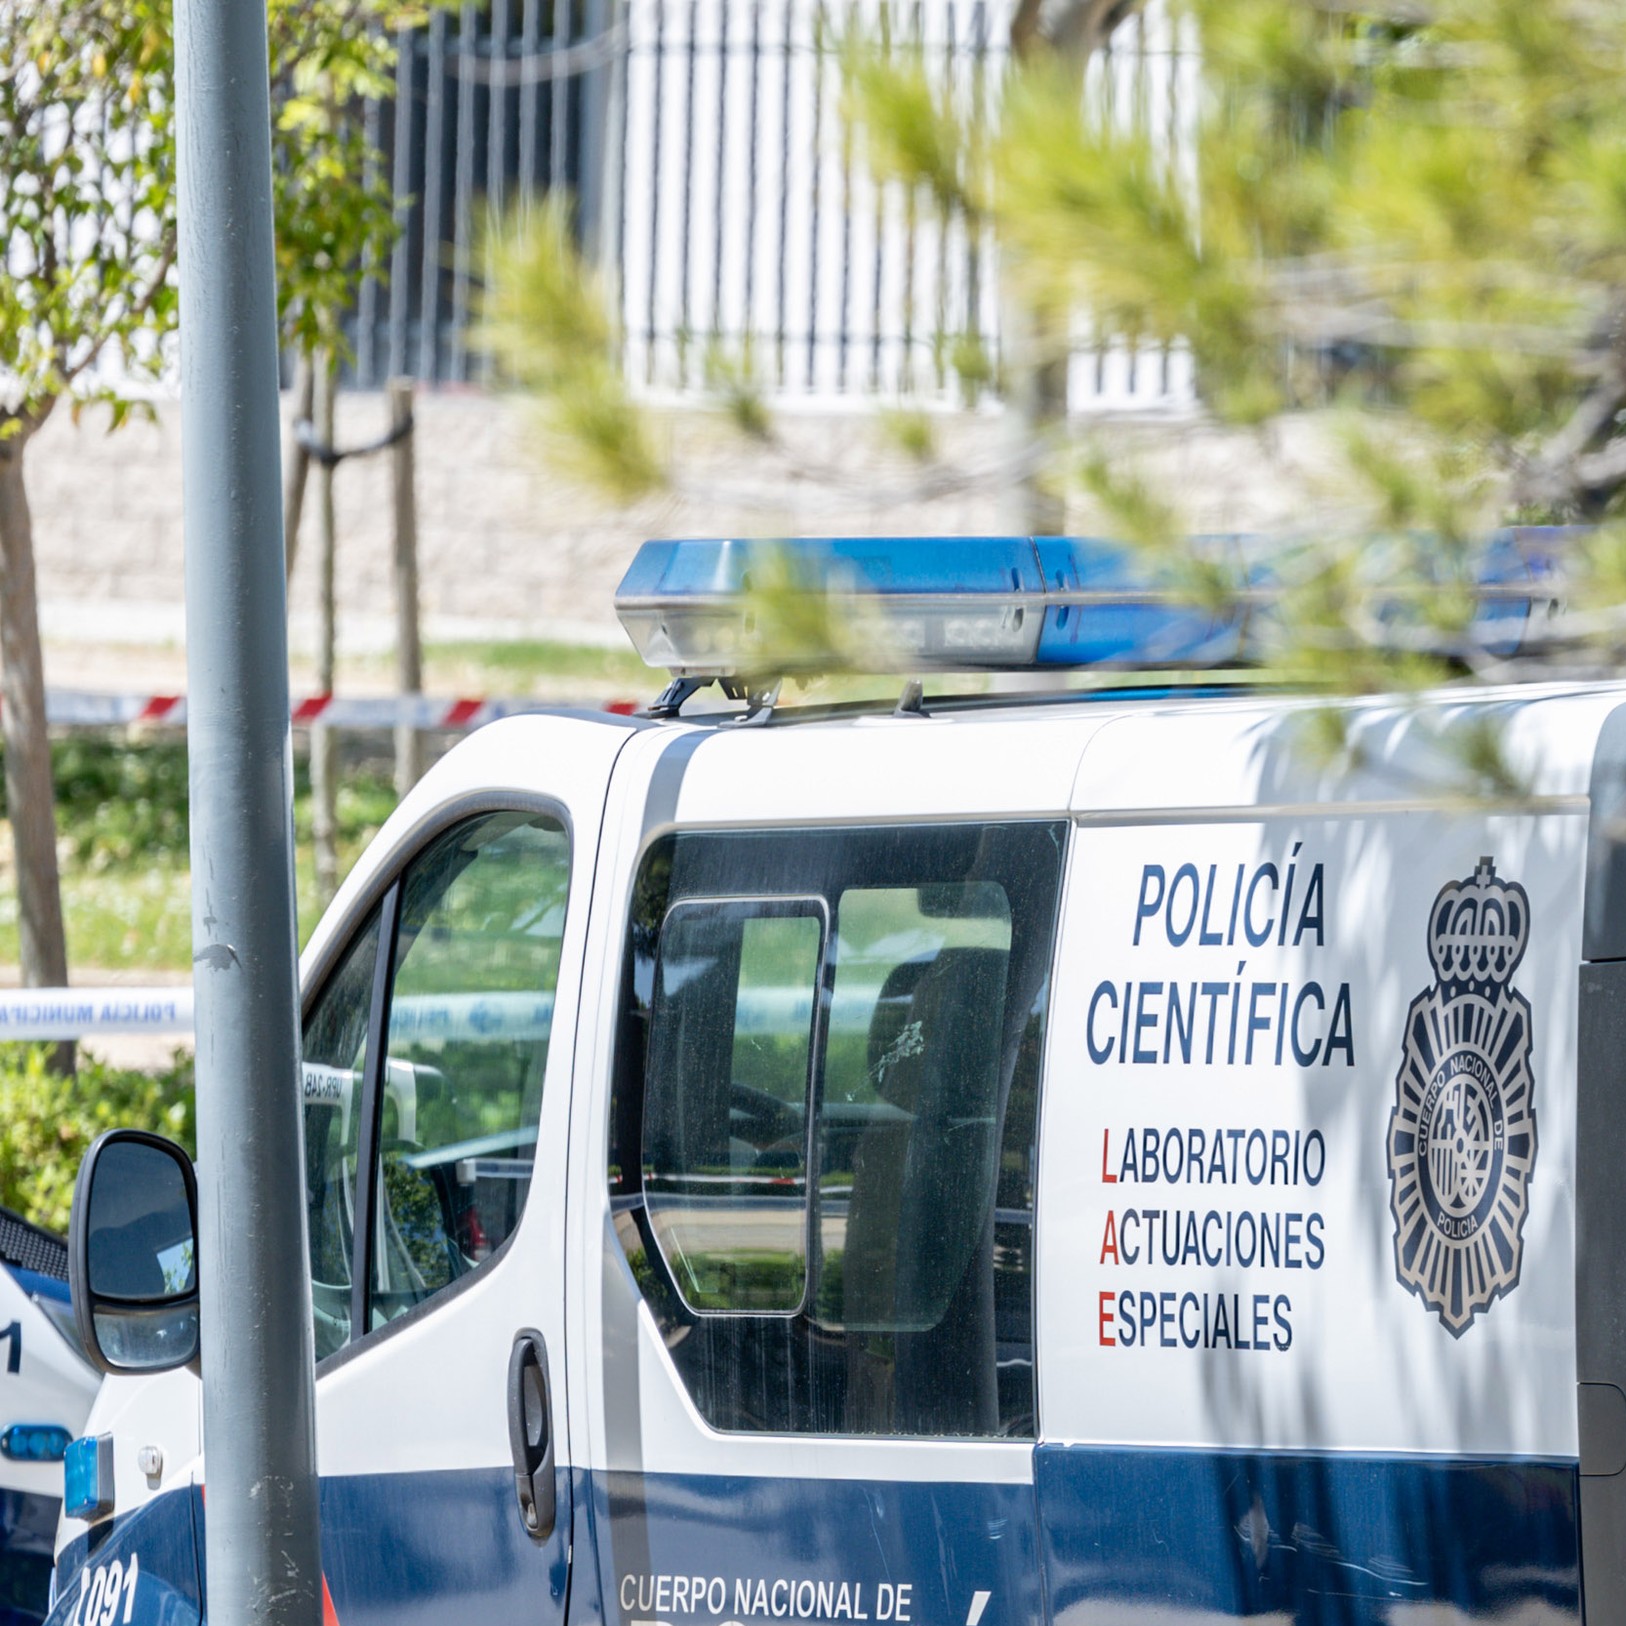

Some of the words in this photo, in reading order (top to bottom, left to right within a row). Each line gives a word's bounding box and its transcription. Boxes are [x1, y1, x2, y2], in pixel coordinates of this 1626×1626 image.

[1132, 843, 1326, 948] POLICÍA
[1086, 960, 1356, 1067] CIENTÍFICA
[1418, 1070, 1447, 1158] CUERPO
[1450, 1055, 1499, 1109] NACIONAL
[1493, 1120, 1504, 1151] DE
[1102, 1127, 1327, 1187] LABORATORIO
[1100, 1210, 1326, 1270] ACTUACIONES
[1436, 1212, 1478, 1239] POLICIA
[1099, 1290, 1293, 1352] ESPECIALES
[619, 1574, 726, 1616] CUERPO
[734, 1578, 868, 1622] NACIONAL
[876, 1583, 912, 1622] DE
